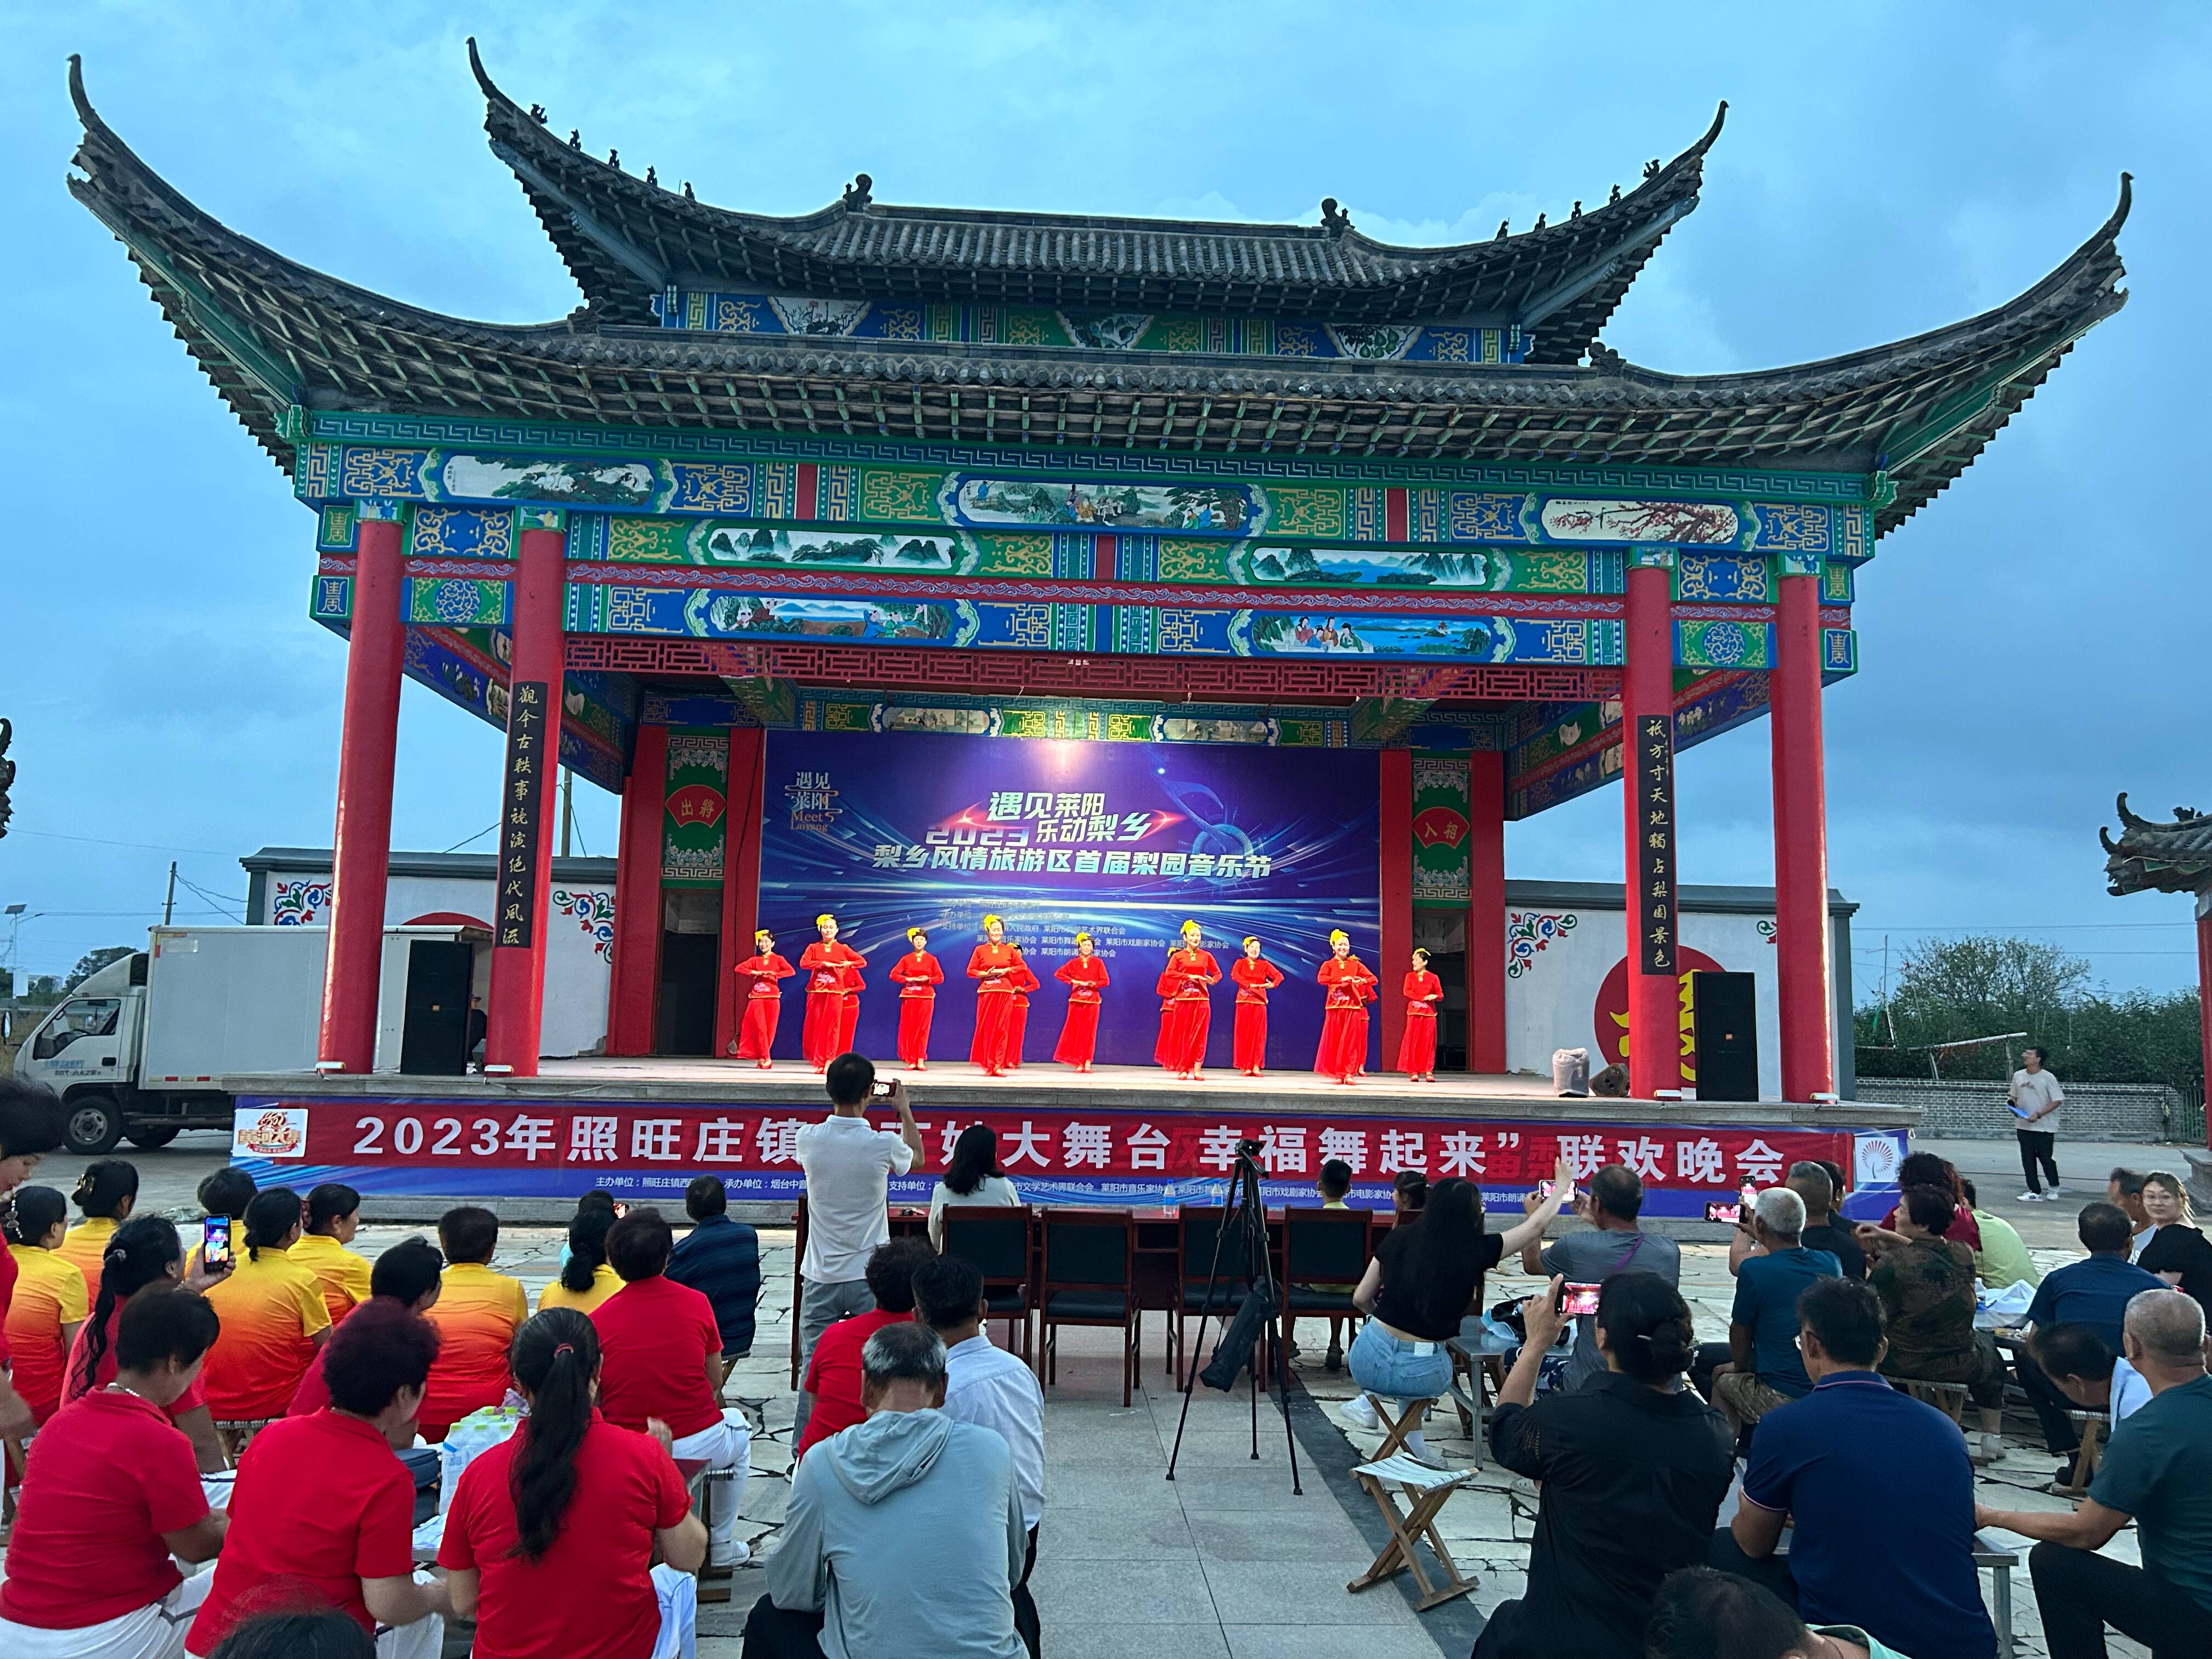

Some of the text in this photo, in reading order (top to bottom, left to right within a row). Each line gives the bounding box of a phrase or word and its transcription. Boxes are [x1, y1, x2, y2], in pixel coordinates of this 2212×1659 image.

[795, 771, 830, 789] 遇见
[790, 791, 829, 810] 莱阳
[987, 792, 1105, 821] 遇见莱阳
[791, 810, 823, 822] Meet
[926, 812, 1152, 847] 2023 乐动梨乡
[1425, 821, 1458, 839] 入相
[872, 844, 1272, 878] 梨乡风情旅游区首届梨园音乐节
[977, 934, 1037, 944] 莱阳音乐家协会
[1041, 936, 1102, 946] 莱阳市舞蹈会
[1106, 938, 1165, 947] 莱阳市戏剧家协会
[354, 1114, 807, 1164] 2023年照旺庄镇
[1557, 1134, 1784, 1184] 联欢晚会
[595, 1177, 694, 1188] 主办单位：照旺庄镇西
[889, 1180, 944, 1191] 支持单位：
[1343, 1188, 1394, 1200] 市电影家协
